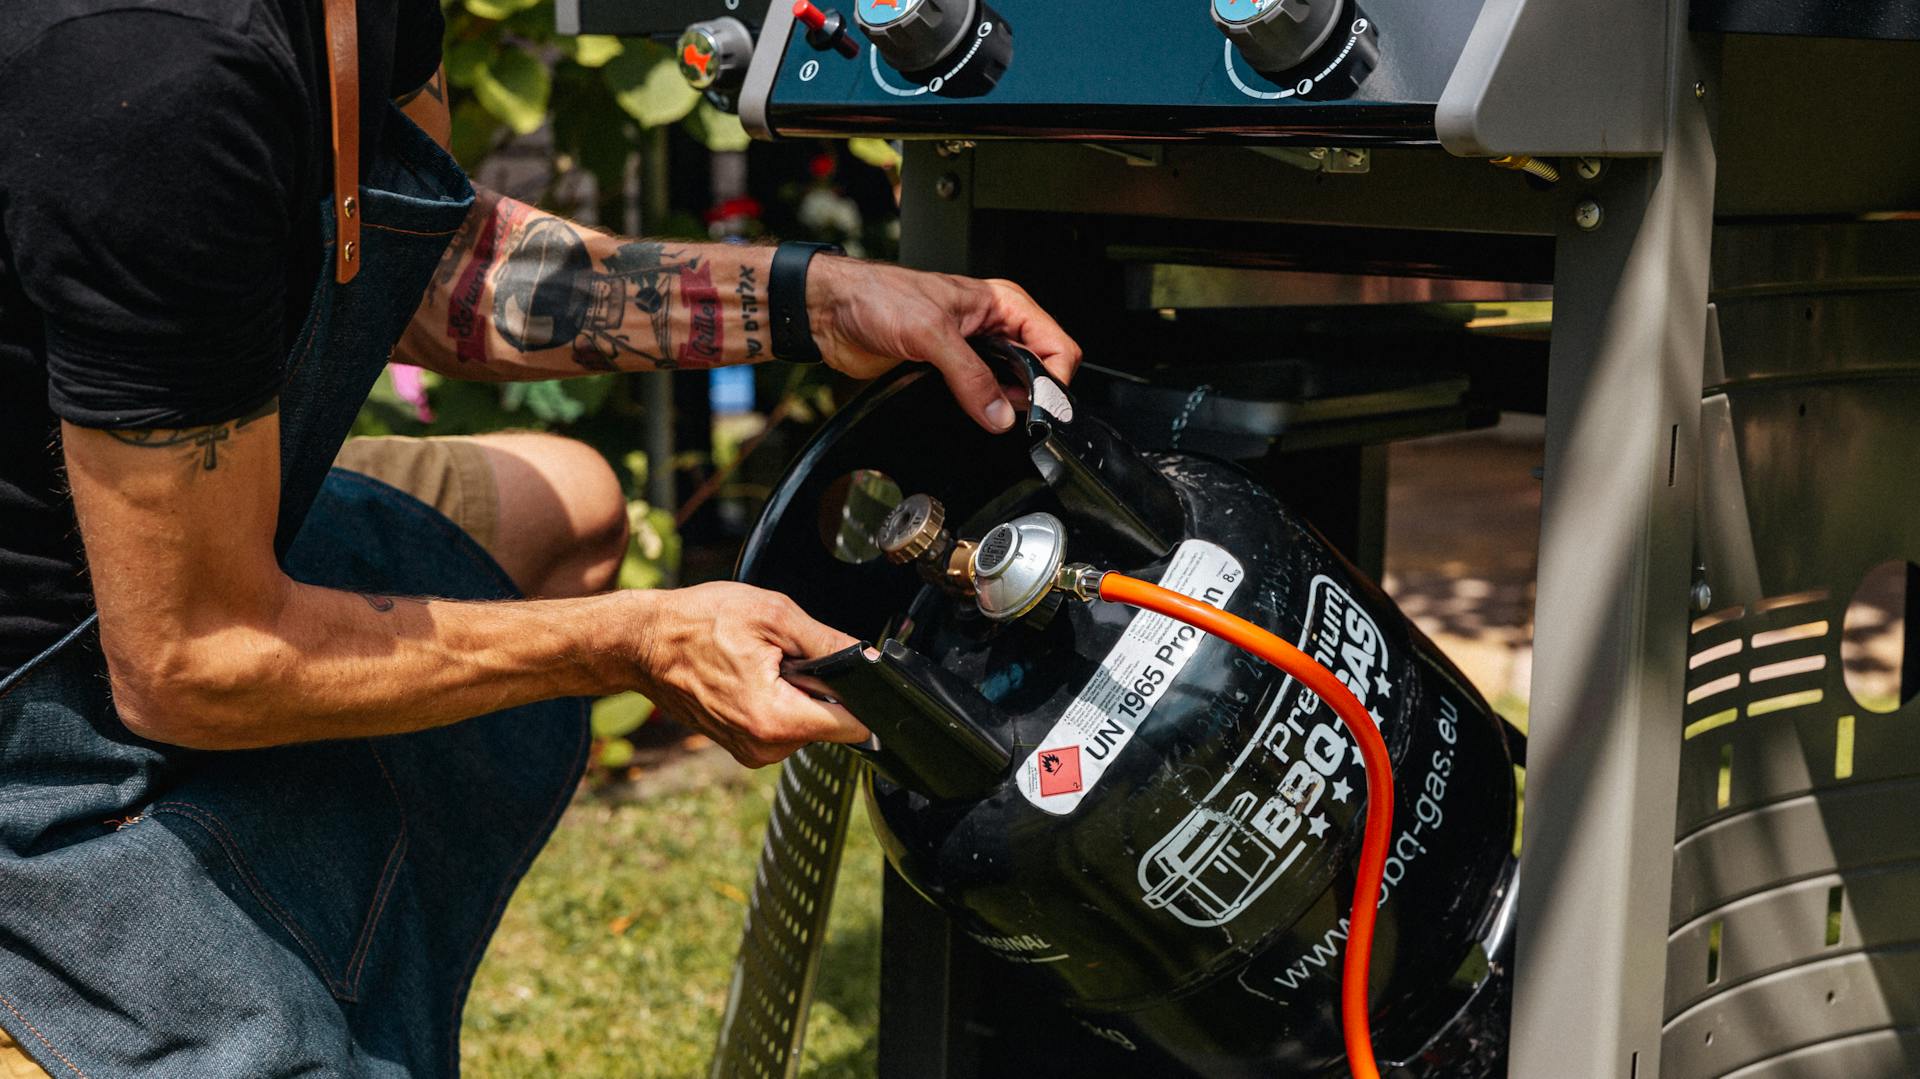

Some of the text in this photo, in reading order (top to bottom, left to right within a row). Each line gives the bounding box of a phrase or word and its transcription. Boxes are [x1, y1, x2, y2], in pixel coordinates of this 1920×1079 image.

[1085, 719, 1125, 761] UN
[1117, 665, 1165, 718] 1965
[1155, 586, 1224, 667] Pron
[1274, 696, 1458, 989] wwwbq-gas.eu
